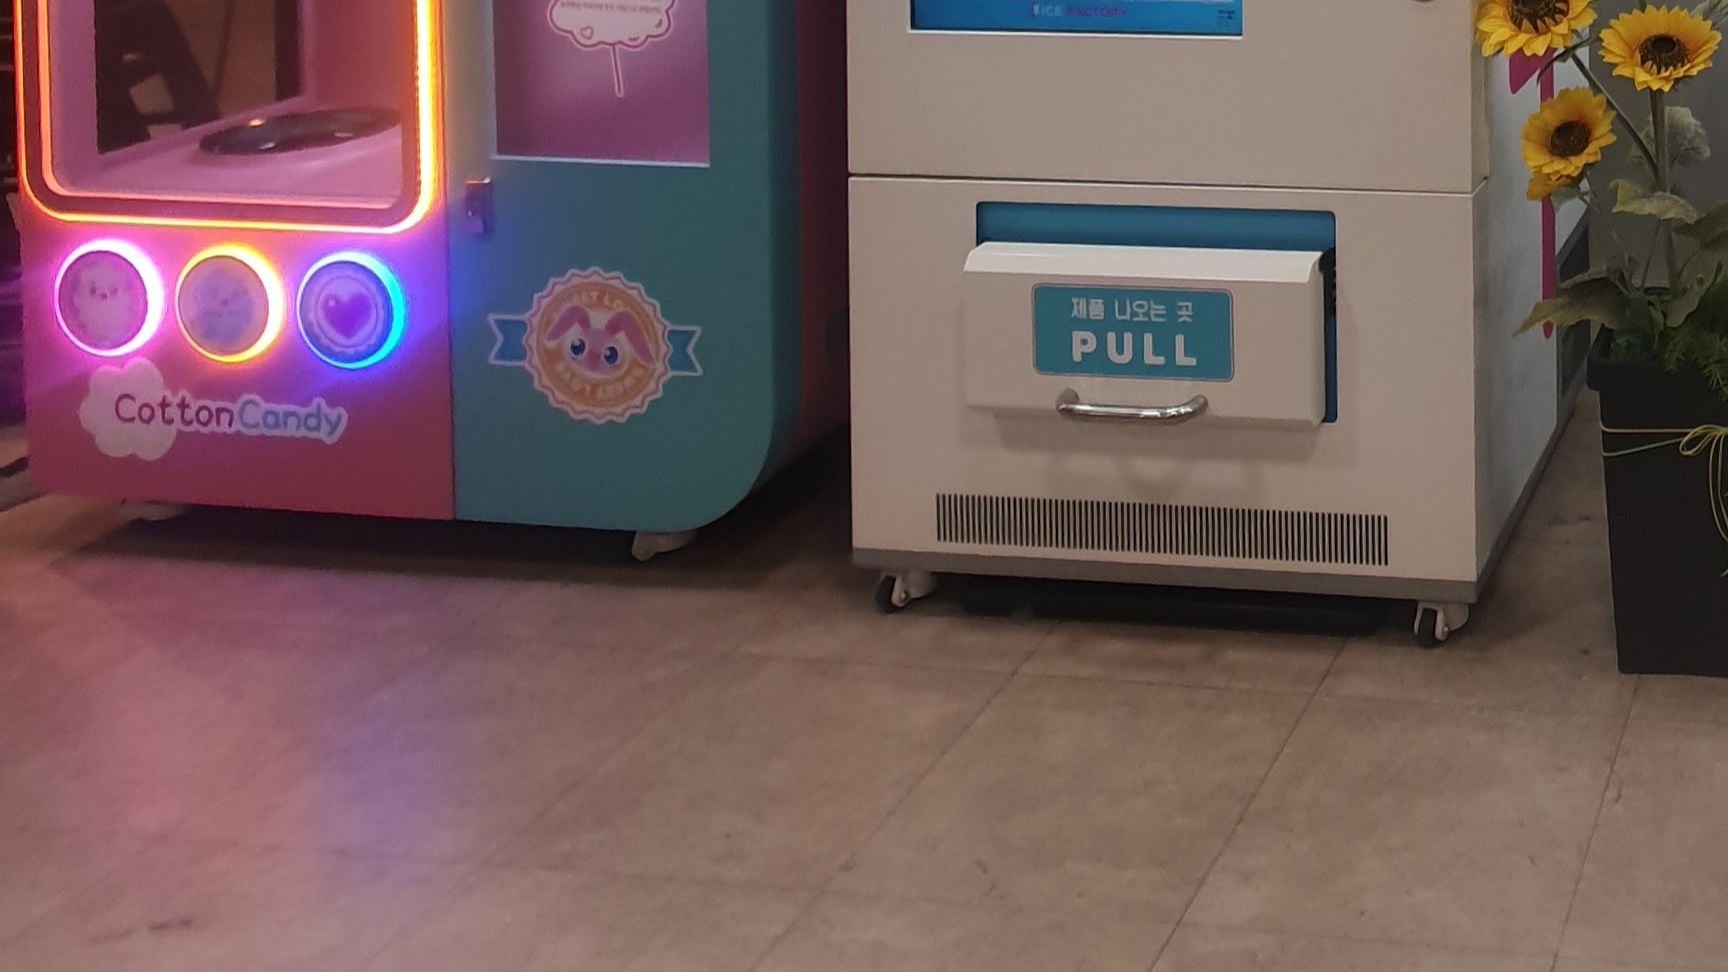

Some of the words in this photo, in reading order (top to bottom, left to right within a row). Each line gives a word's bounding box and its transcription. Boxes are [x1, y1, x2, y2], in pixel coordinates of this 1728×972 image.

[1071, 297, 1105, 320] 제품
[1115, 298, 1167, 322] 나오는
[1177, 301, 1194, 323] 곳
[1071, 330, 1197, 367] PULL
